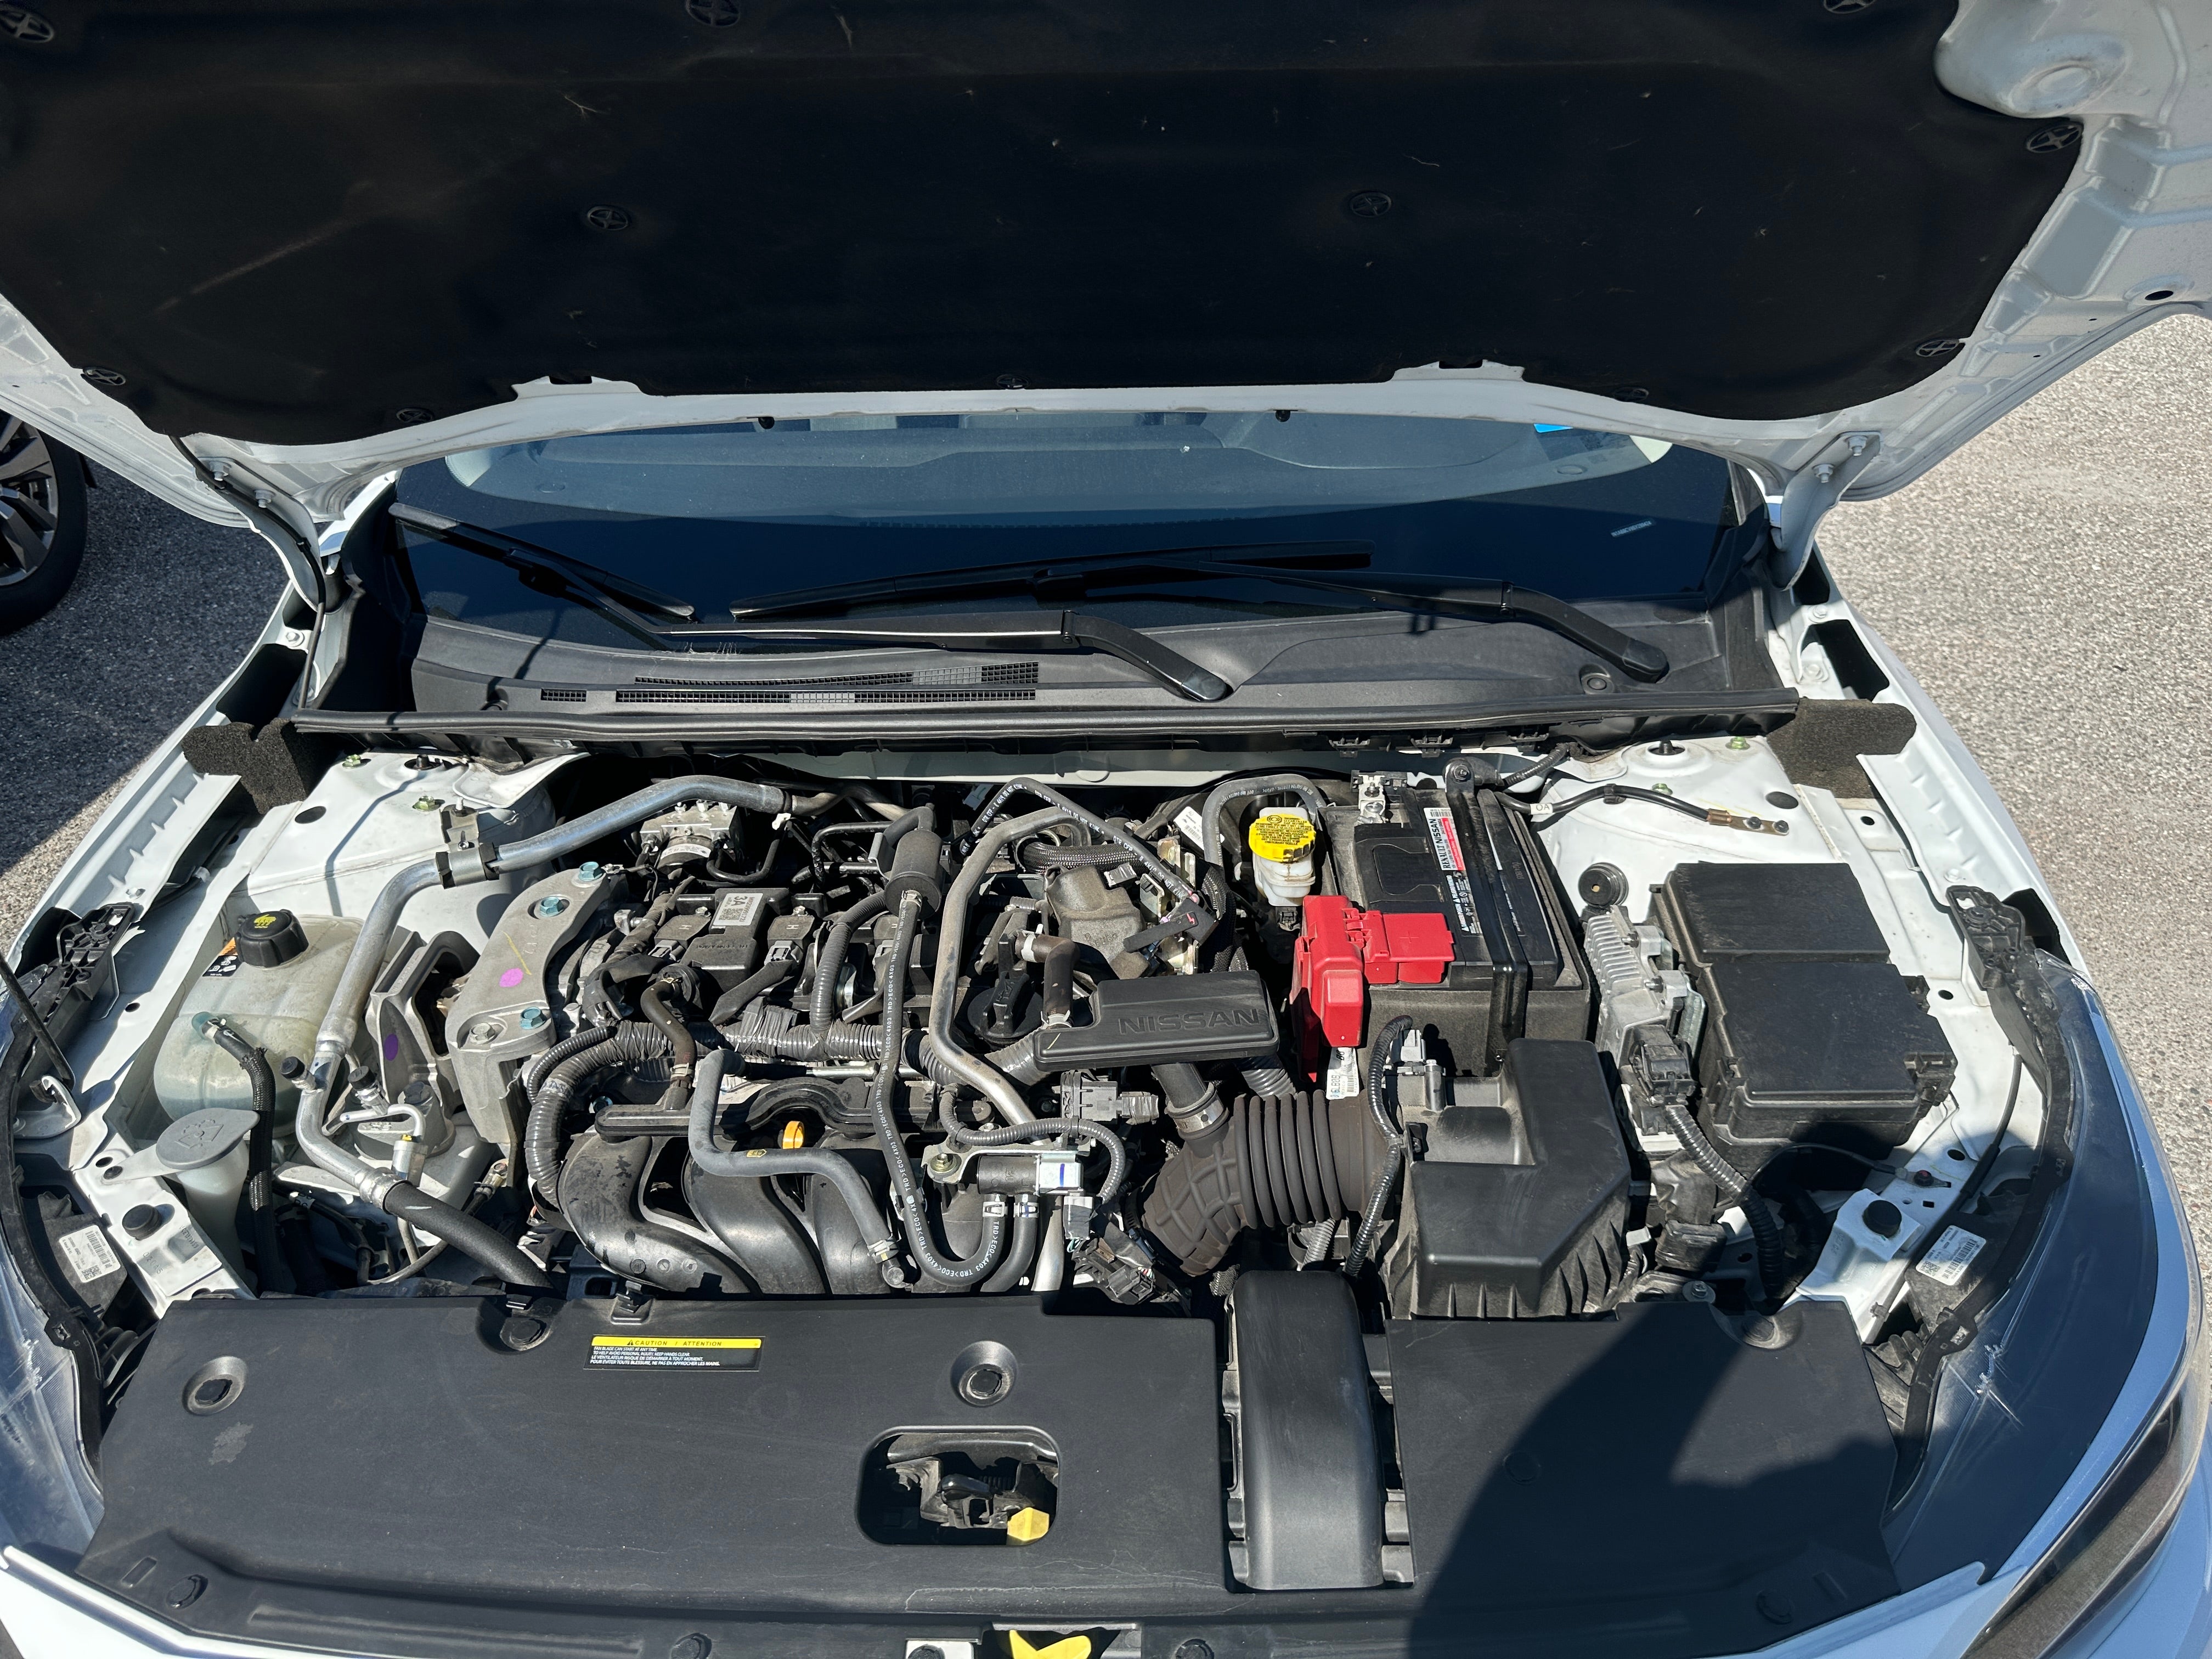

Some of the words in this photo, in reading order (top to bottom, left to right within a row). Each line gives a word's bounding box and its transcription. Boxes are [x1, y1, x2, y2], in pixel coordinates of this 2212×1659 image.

[1428, 818, 1443, 844] NISSAN
[1437, 845, 1451, 869] RENAULT
[1119, 1008, 1260, 1035] NISSAN
